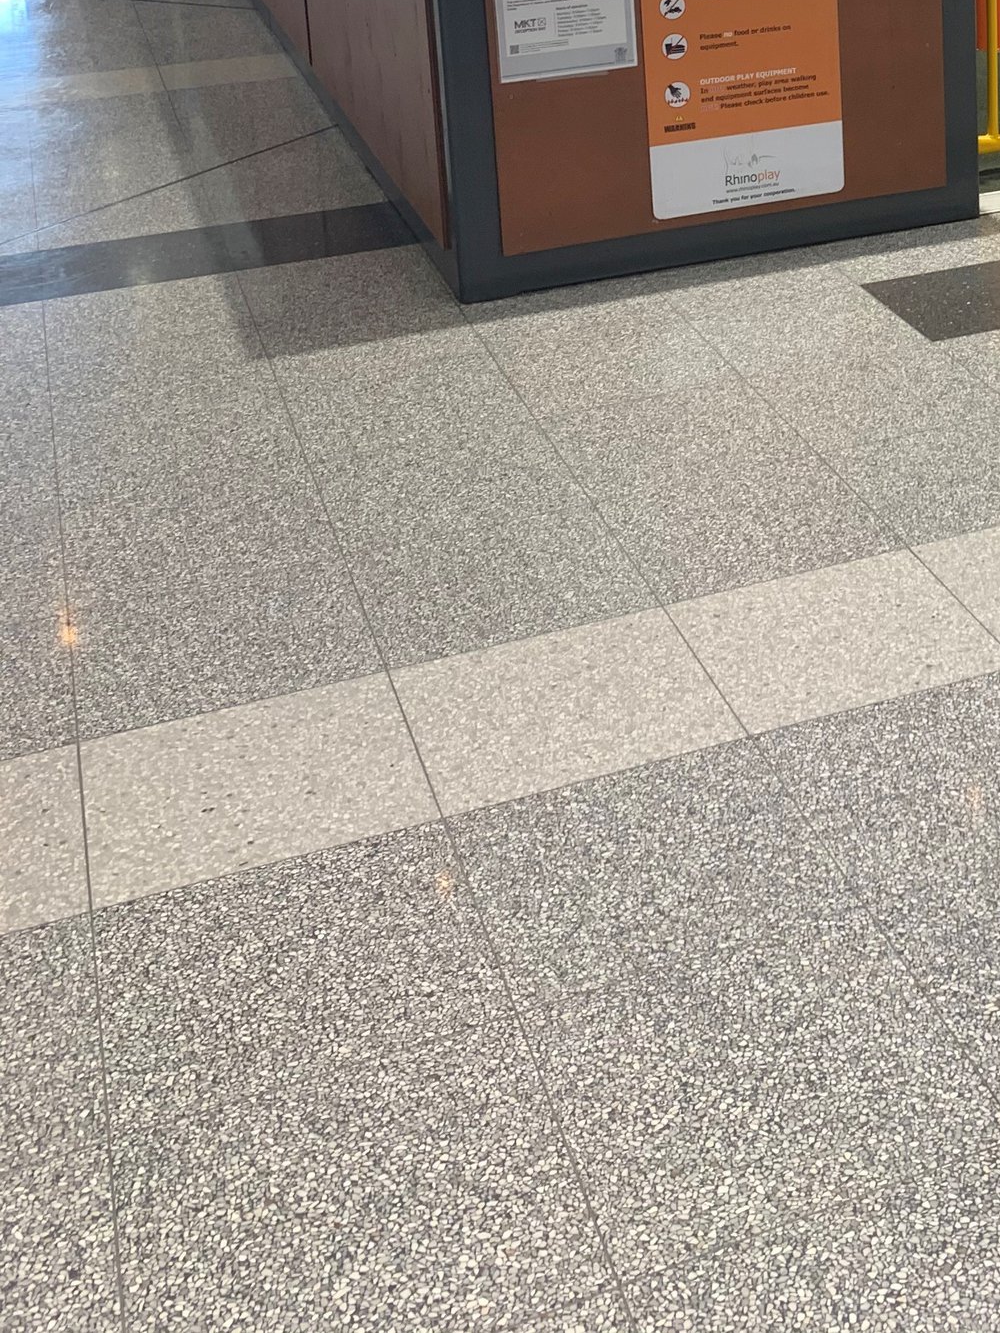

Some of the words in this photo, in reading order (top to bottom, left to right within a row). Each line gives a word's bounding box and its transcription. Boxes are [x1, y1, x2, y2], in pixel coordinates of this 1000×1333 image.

[514, 18, 536, 29] MKT
[700, 32, 722, 40] Please
[734, 28, 750, 36] food
[759, 25, 781, 33] drinks
[700, 41, 739, 51] equipment.
[699, 75, 735, 85] OUTDOOR
[736, 72, 755, 81] PLAY
[755, 67, 797, 78] EQUIPMENT
[758, 79, 772, 88] play
[790, 74, 817, 83] walking
[701, 95, 714, 103] and
[715, 91, 752, 102] equipment
[753, 87, 782, 96] surfaces
[783, 83, 809, 92] become
[720, 101, 742, 110] Please
[743, 98, 763, 107] check
[765, 95, 787, 104] before
[788, 91, 815, 101] children
[725, 169, 781, 187] Rhinoplay
[712, 197, 729, 205] Thank
